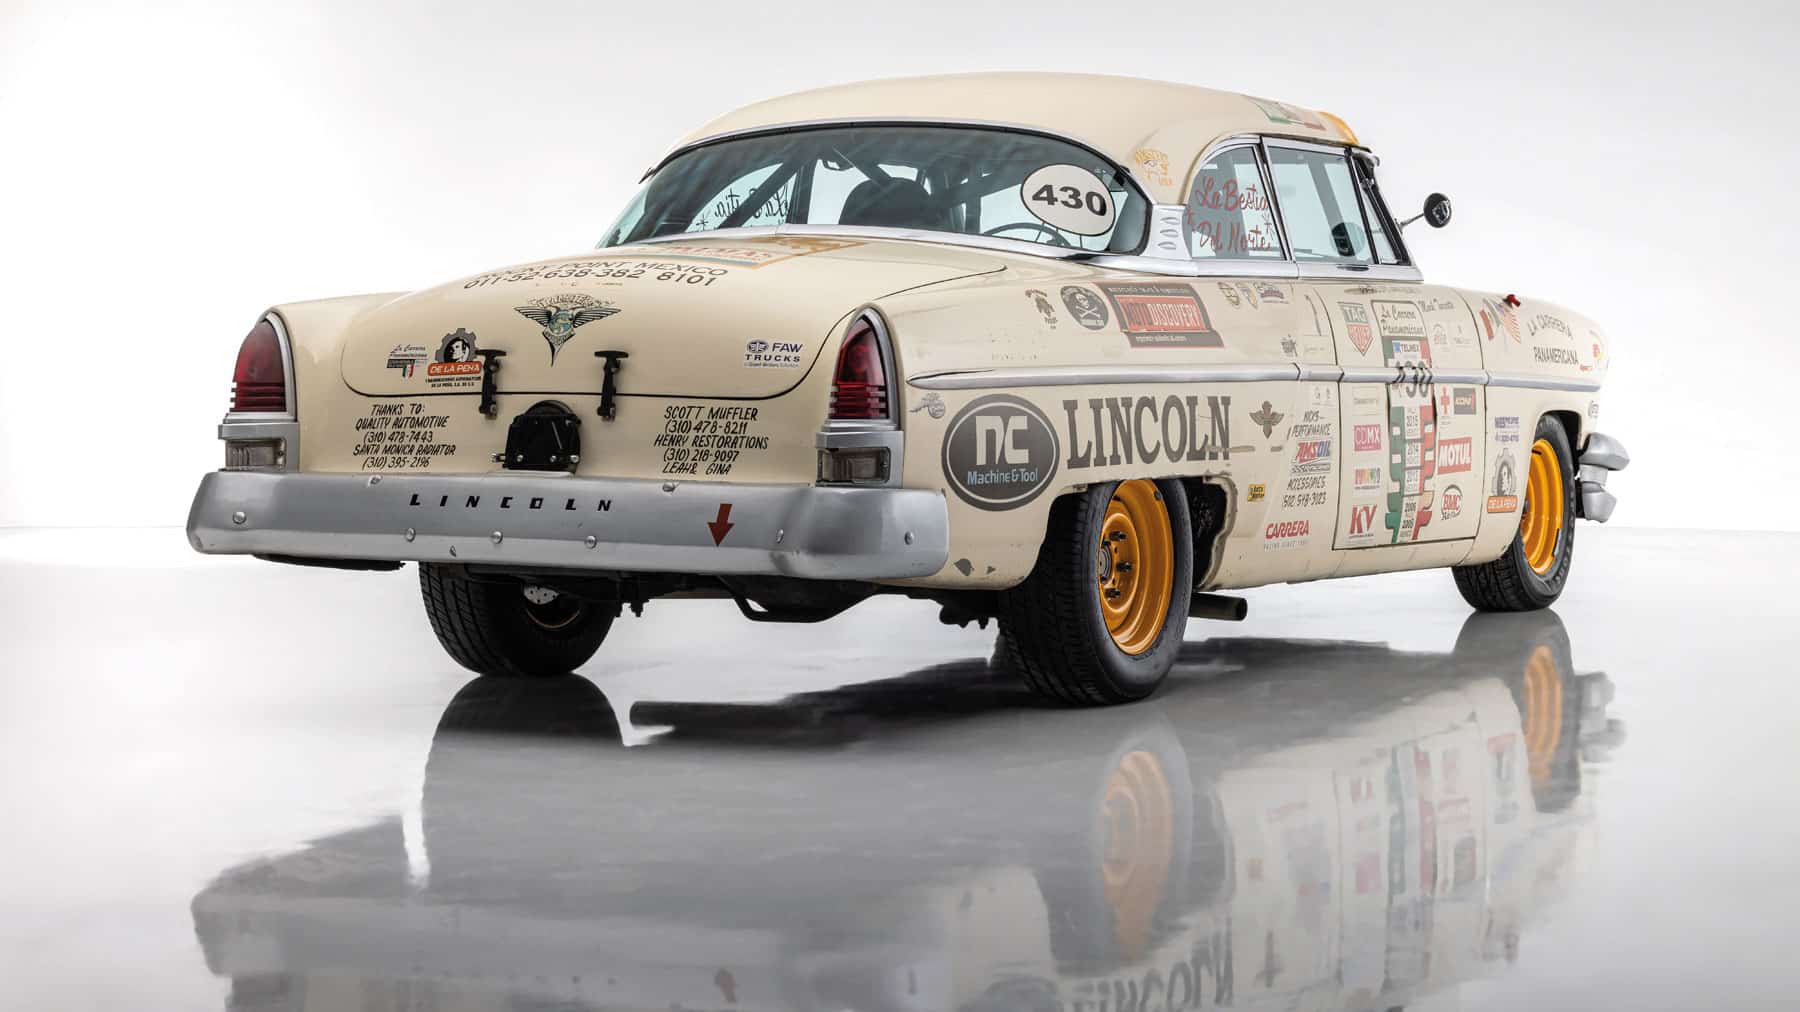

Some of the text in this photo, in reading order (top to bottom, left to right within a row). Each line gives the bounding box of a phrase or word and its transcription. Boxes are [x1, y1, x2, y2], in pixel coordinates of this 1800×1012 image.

[1032, 184, 1108, 217] 430
[633, 262, 728, 276] MEXICO
[656, 271, 717, 287] 8101
[772, 342, 803, 353] FAW
[745, 354, 801, 362] TRUCKS
[371, 403, 426, 416] THANKS TO:
[664, 406, 758, 421] SCOTT MUFFLER
[355, 415, 450, 430] QUALITY AUTOMOTIVE
[665, 419, 748, 434] (310) 478-8211
[363, 431, 433, 445] (310) 478-7443
[1063, 395, 1231, 469] LINCOLN
[1356, 427, 1381, 447] CDMX
[654, 434, 769, 450] HENRY RESTORATIONS
[353, 444, 457, 456] SANTA MONICA RADIATOR
[663, 448, 690, 462] (310)
[1440, 443, 1471, 467] MOTUL
[362, 456, 430, 470] (310) 395-2196
[705, 463, 732, 475] GINA
[409, 494, 612, 512] LINCOLN
[1443, 495, 1461, 511] BMC
[1349, 504, 1378, 534] KV
[1266, 520, 1309, 539] CARRERA
